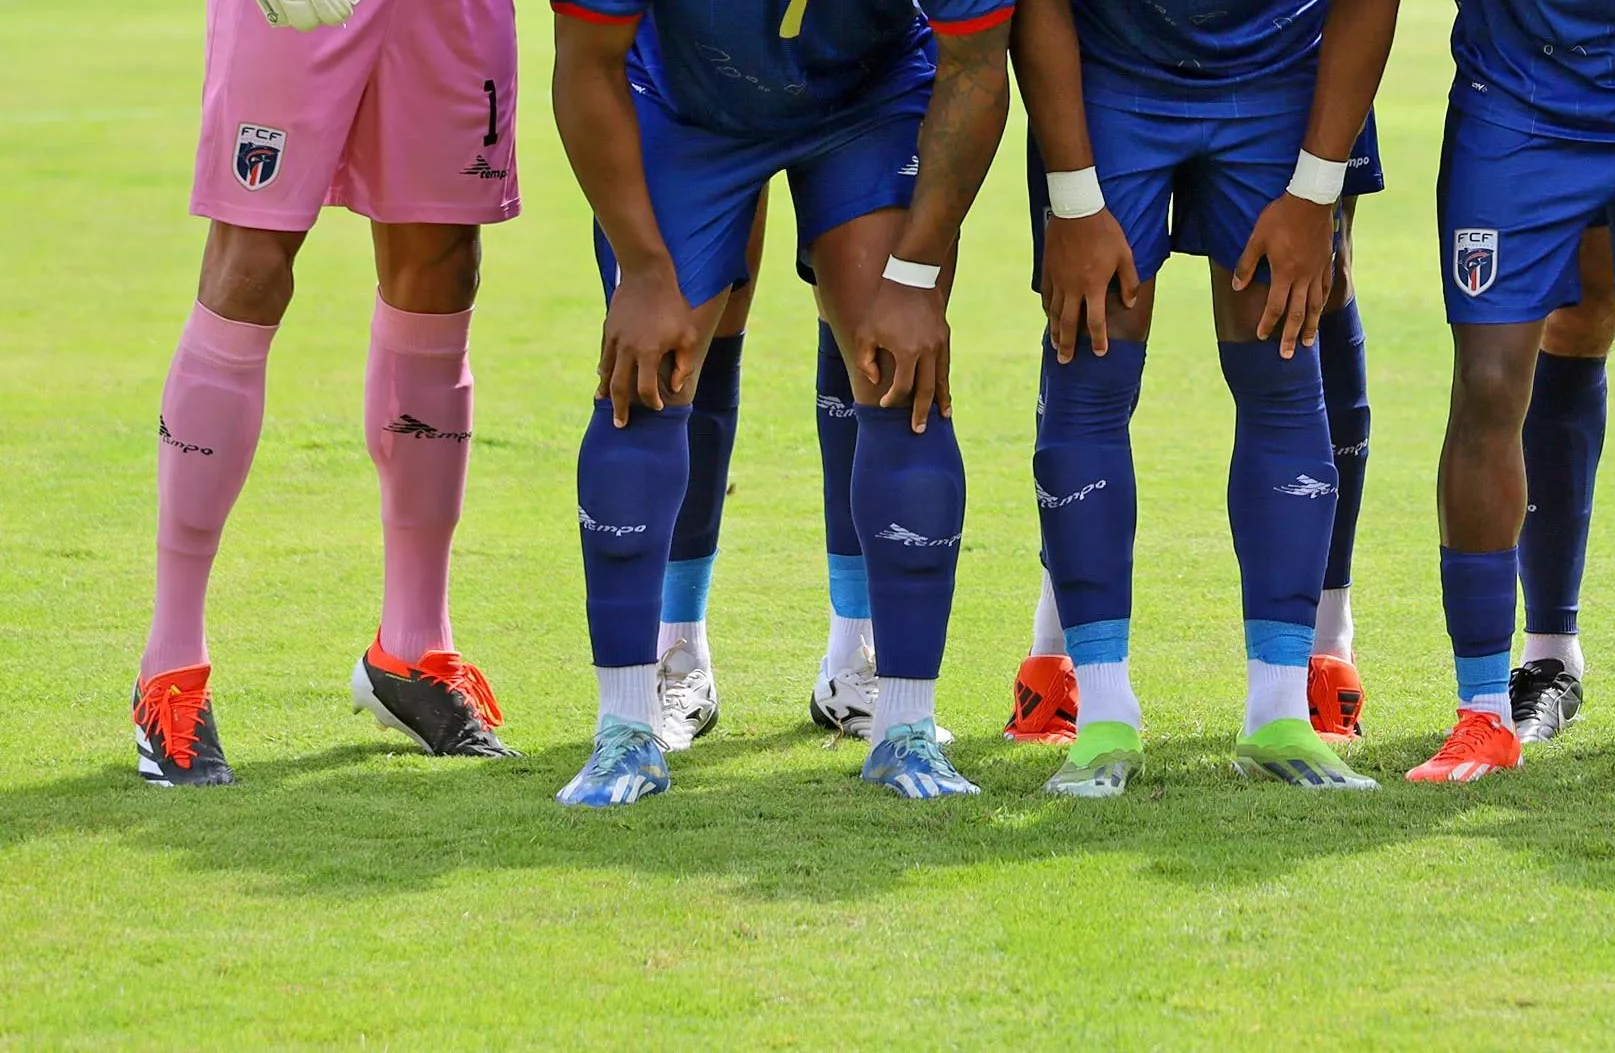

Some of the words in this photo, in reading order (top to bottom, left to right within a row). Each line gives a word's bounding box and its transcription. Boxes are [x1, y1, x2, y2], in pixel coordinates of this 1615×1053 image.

[483, 79, 499, 147] 1
[241, 126, 283, 140] FCF
[1348, 155, 1370, 168] mpo
[1457, 232, 1492, 243] FCF
[583, 520, 646, 537] tempo
